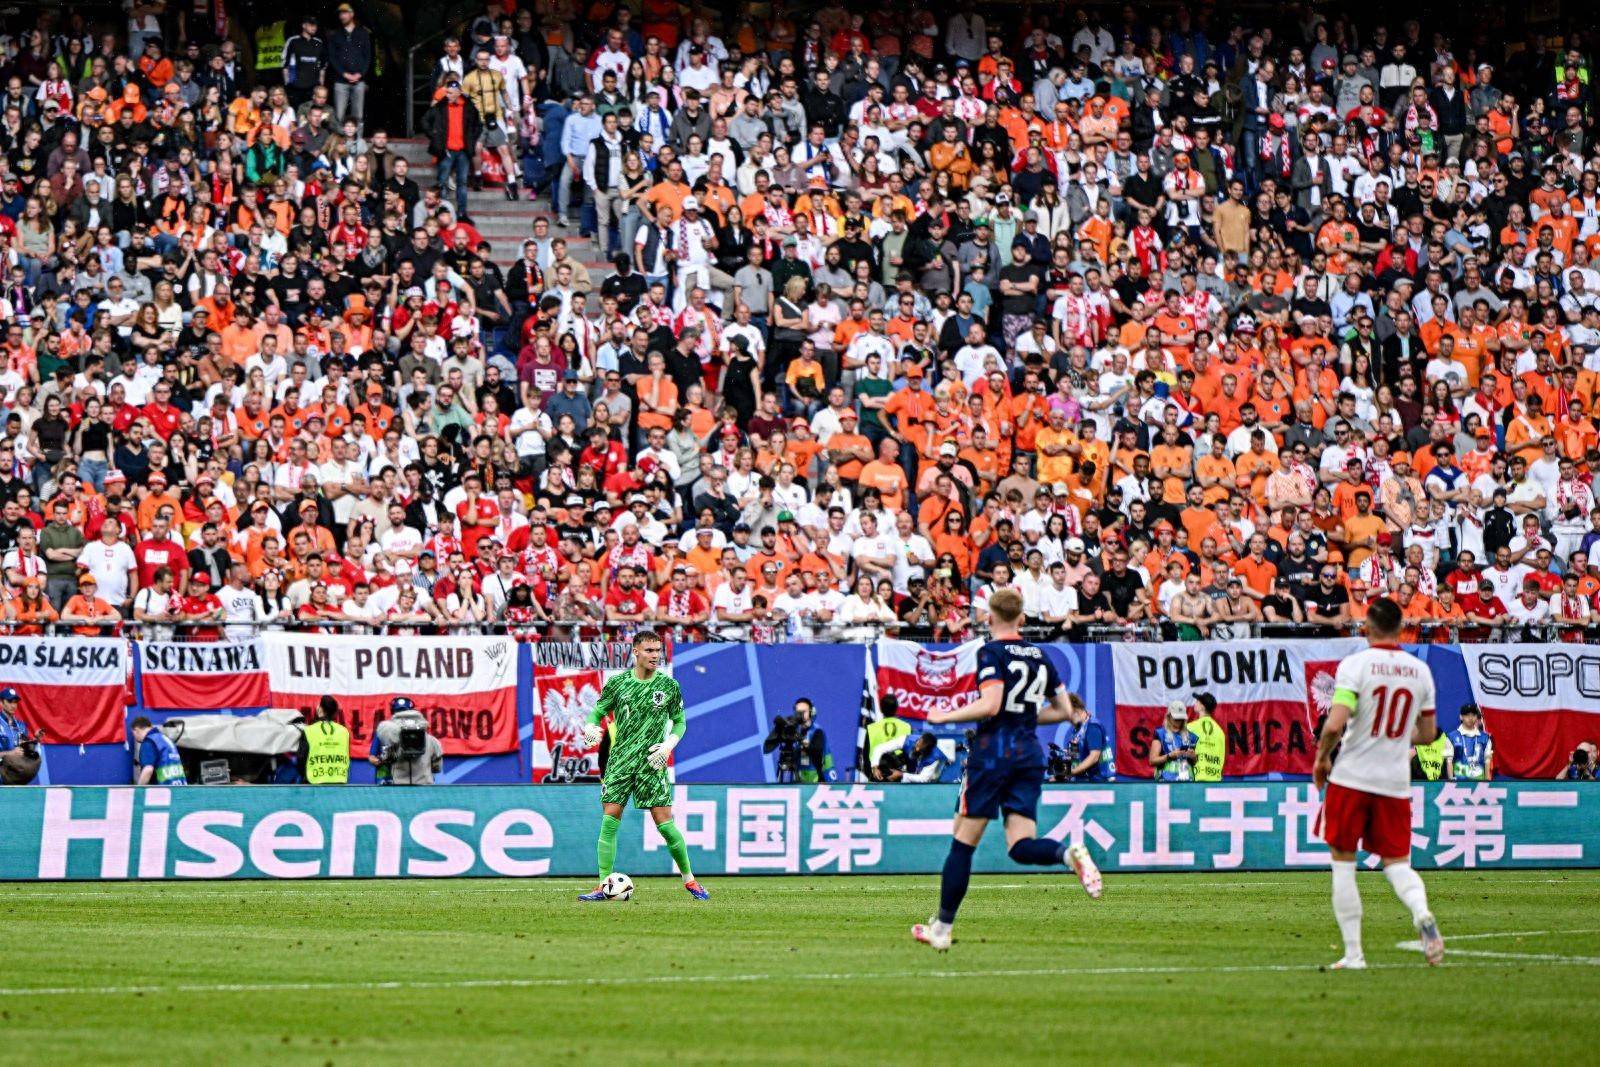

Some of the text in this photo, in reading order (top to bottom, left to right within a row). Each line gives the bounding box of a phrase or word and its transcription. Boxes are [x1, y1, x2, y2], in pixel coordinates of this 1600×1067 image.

[0, 643, 27, 665] DA
[33, 641, 119, 675] ŚLĄSKA
[287, 646, 330, 678] LM
[355, 646, 474, 679] POLAND
[537, 641, 584, 667] NOWA
[1137, 649, 1293, 689] POLONIA
[1005, 660, 1048, 714] 24
[1371, 684, 1414, 739] 10
[38, 787, 555, 879] Hisense
[1040, 782, 1584, 869] 不止于世第二
